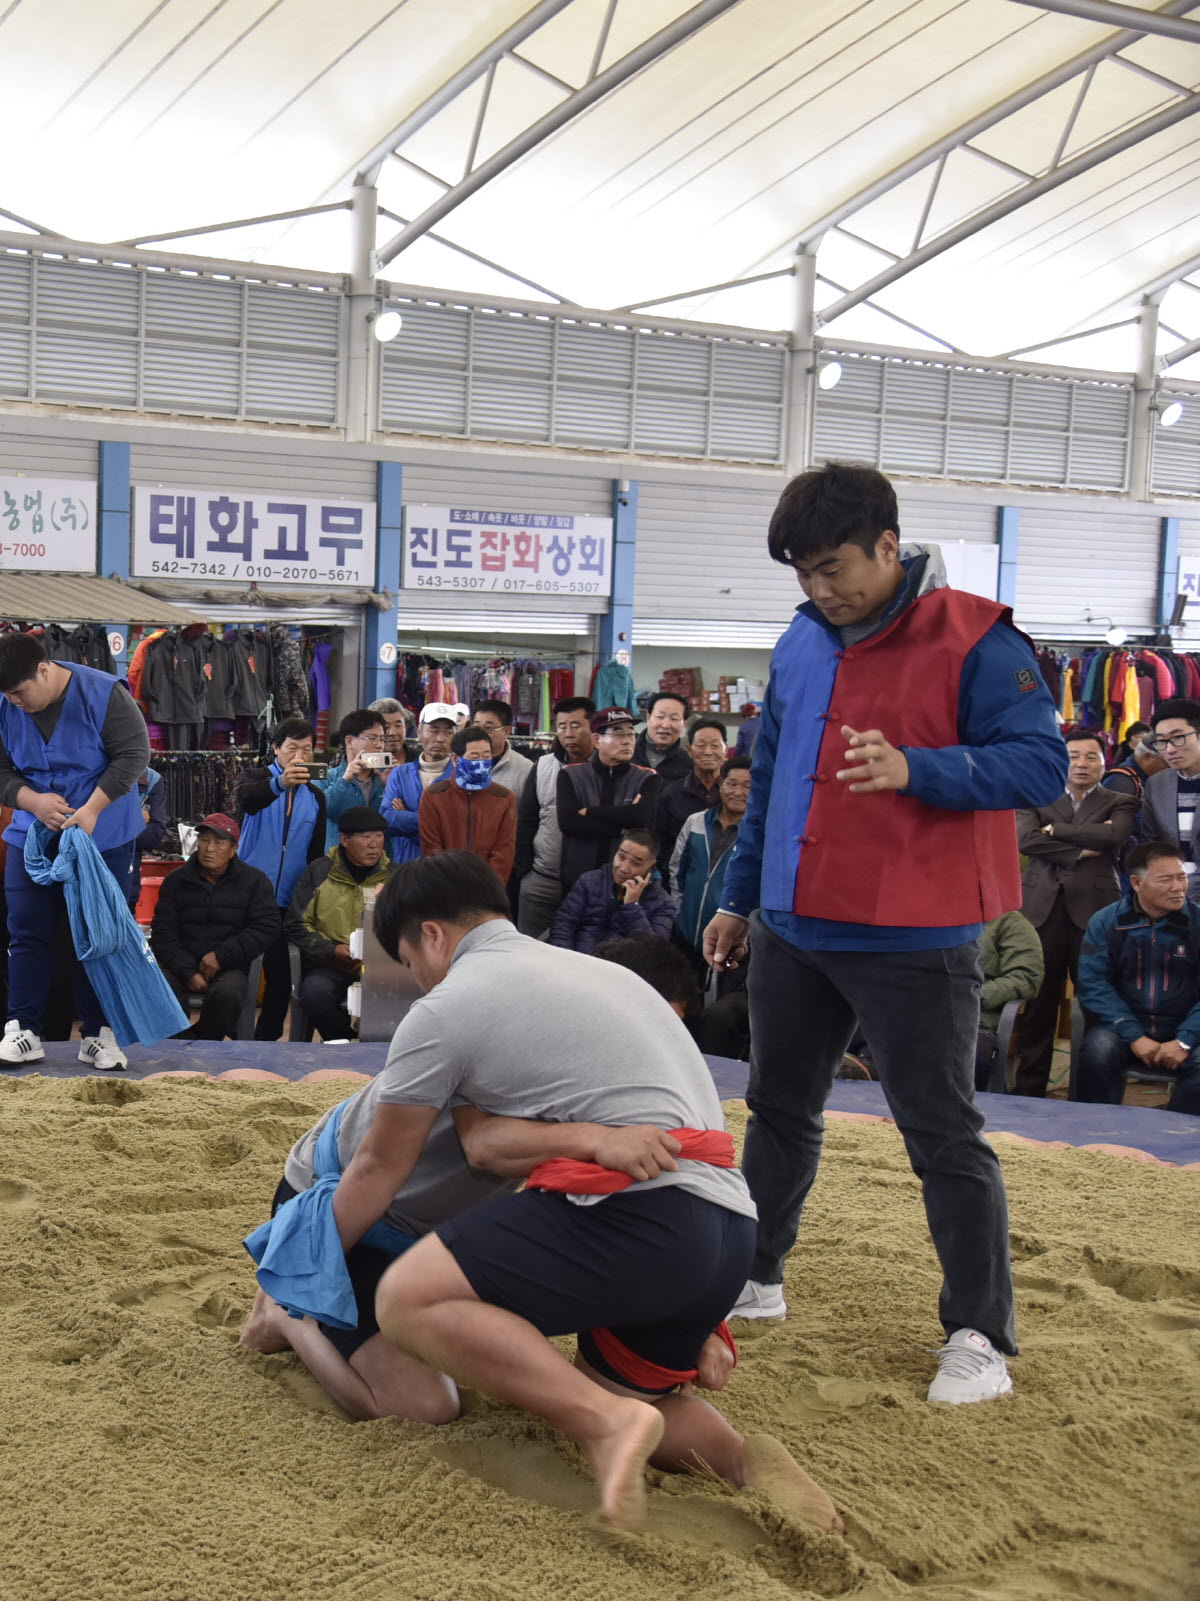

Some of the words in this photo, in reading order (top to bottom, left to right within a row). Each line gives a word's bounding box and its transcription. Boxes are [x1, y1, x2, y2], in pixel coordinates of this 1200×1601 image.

[149, 494, 363, 566] 태화고무
[409, 527, 605, 576] 진도잡화상회
[151, 561, 226, 576] 542-7342
[246, 565, 359, 582] 010-2070-5671
[417, 575, 486, 589] 543-5307
[503, 578, 600, 593] 017-605-5307
[112, 635, 122, 651] 6
[385, 646, 393, 660] 7
